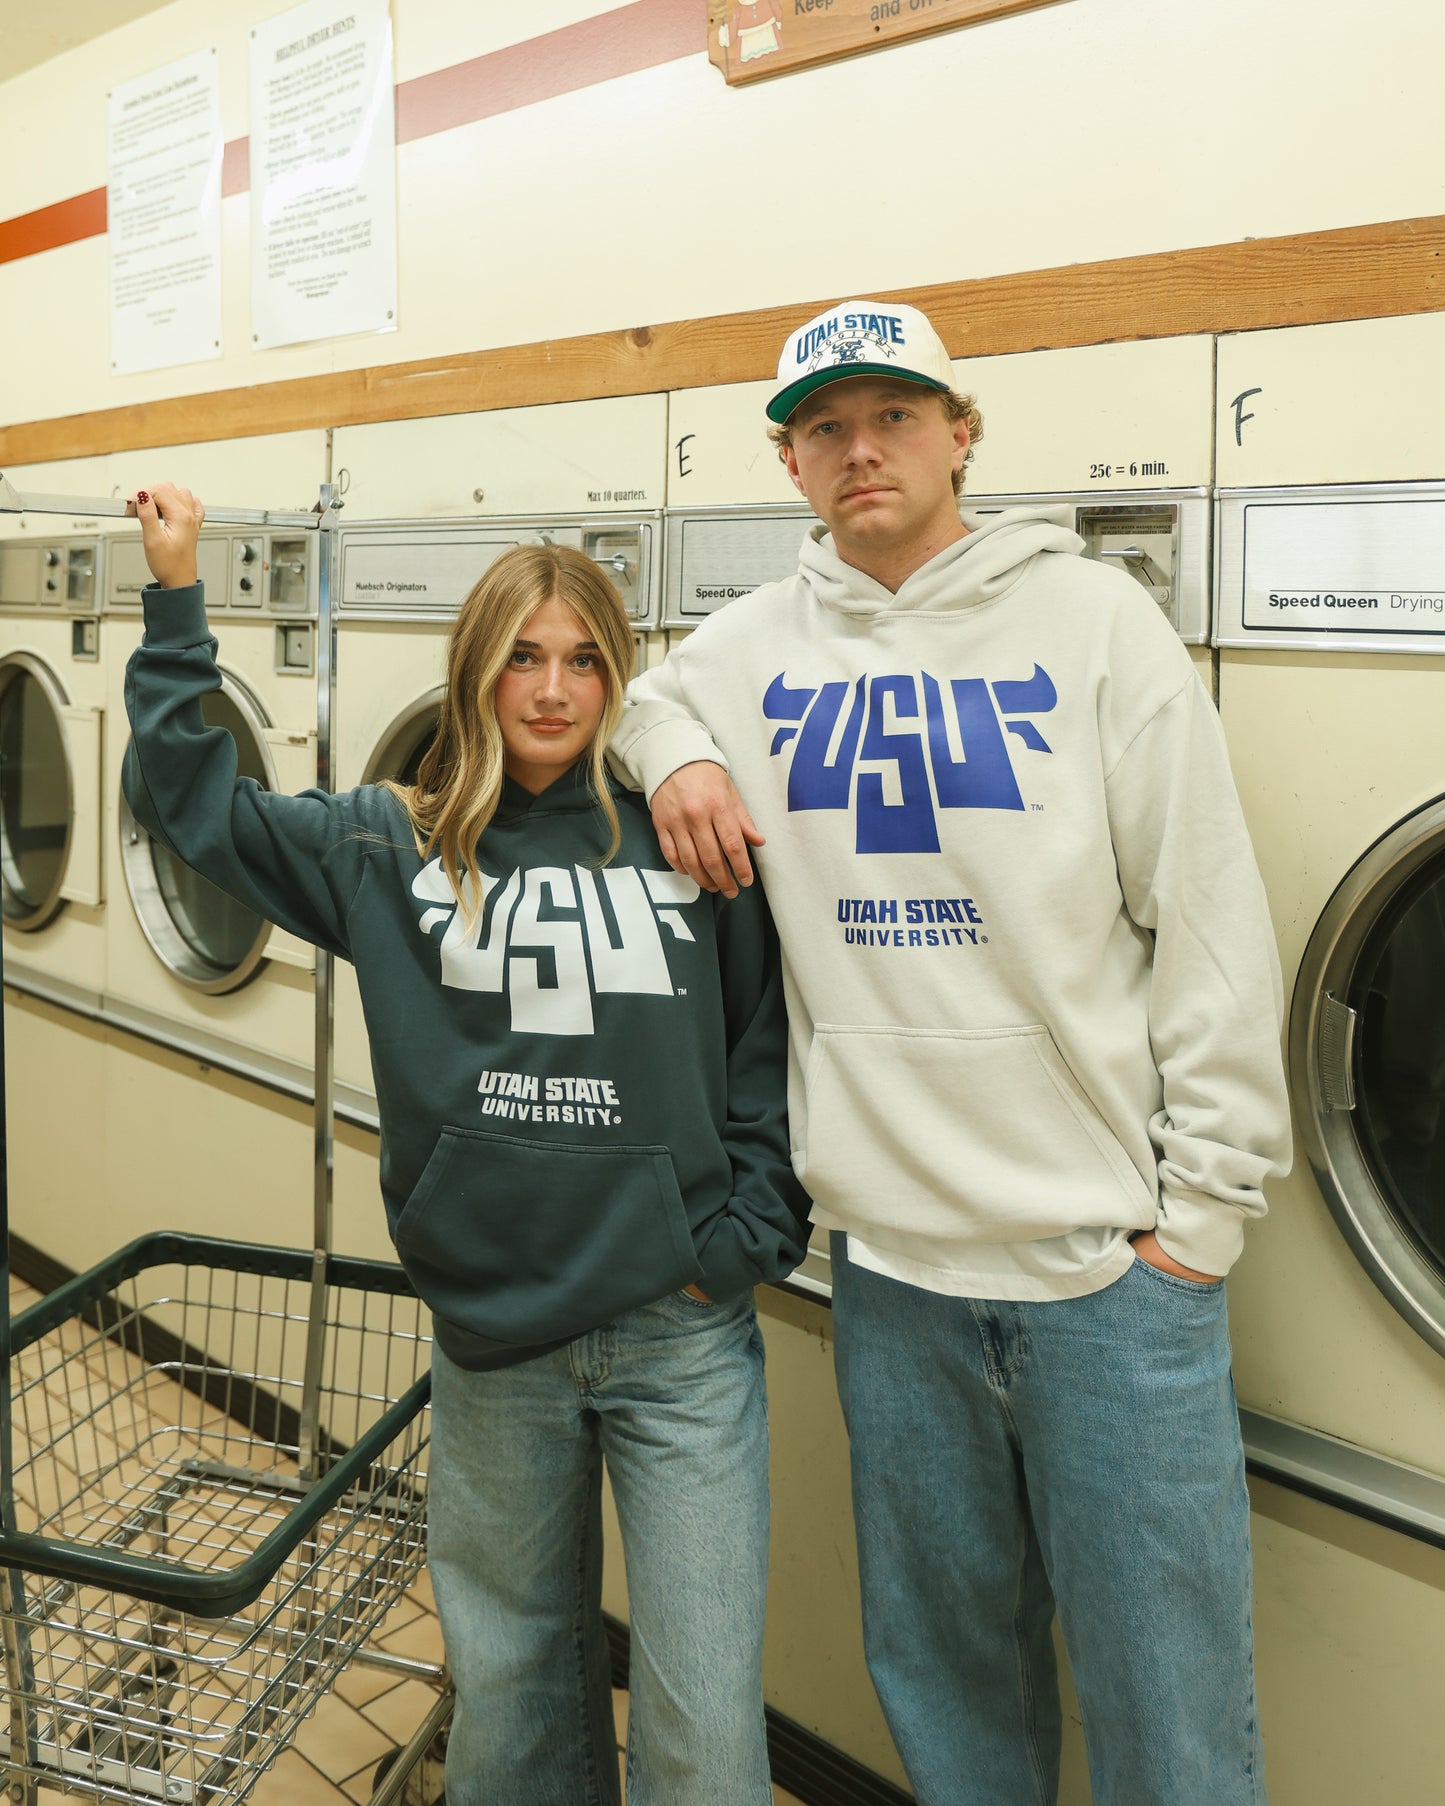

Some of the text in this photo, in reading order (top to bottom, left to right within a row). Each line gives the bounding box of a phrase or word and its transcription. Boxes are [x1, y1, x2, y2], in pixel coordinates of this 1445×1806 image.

[870, 0, 900, 21] and
[796, 313, 906, 364] UTAH STATE
[1230, 387, 1262, 446] F
[675, 434, 696, 477] E
[1090, 463, 1112, 479] 25¢
[1129, 461, 1138, 476] 6
[1141, 460, 1169, 476] min.
[587, 489, 647, 502] Max 10 quarters.
[355, 582, 427, 593] Huebsch Originators
[696, 588, 725, 600] Speed
[1269, 594, 1444, 613] Speed Queen Drying
[786, 670, 1026, 855] USU
[837, 898, 983, 924] UTAH STATE
[477, 1070, 621, 1105] UTAH STATE
